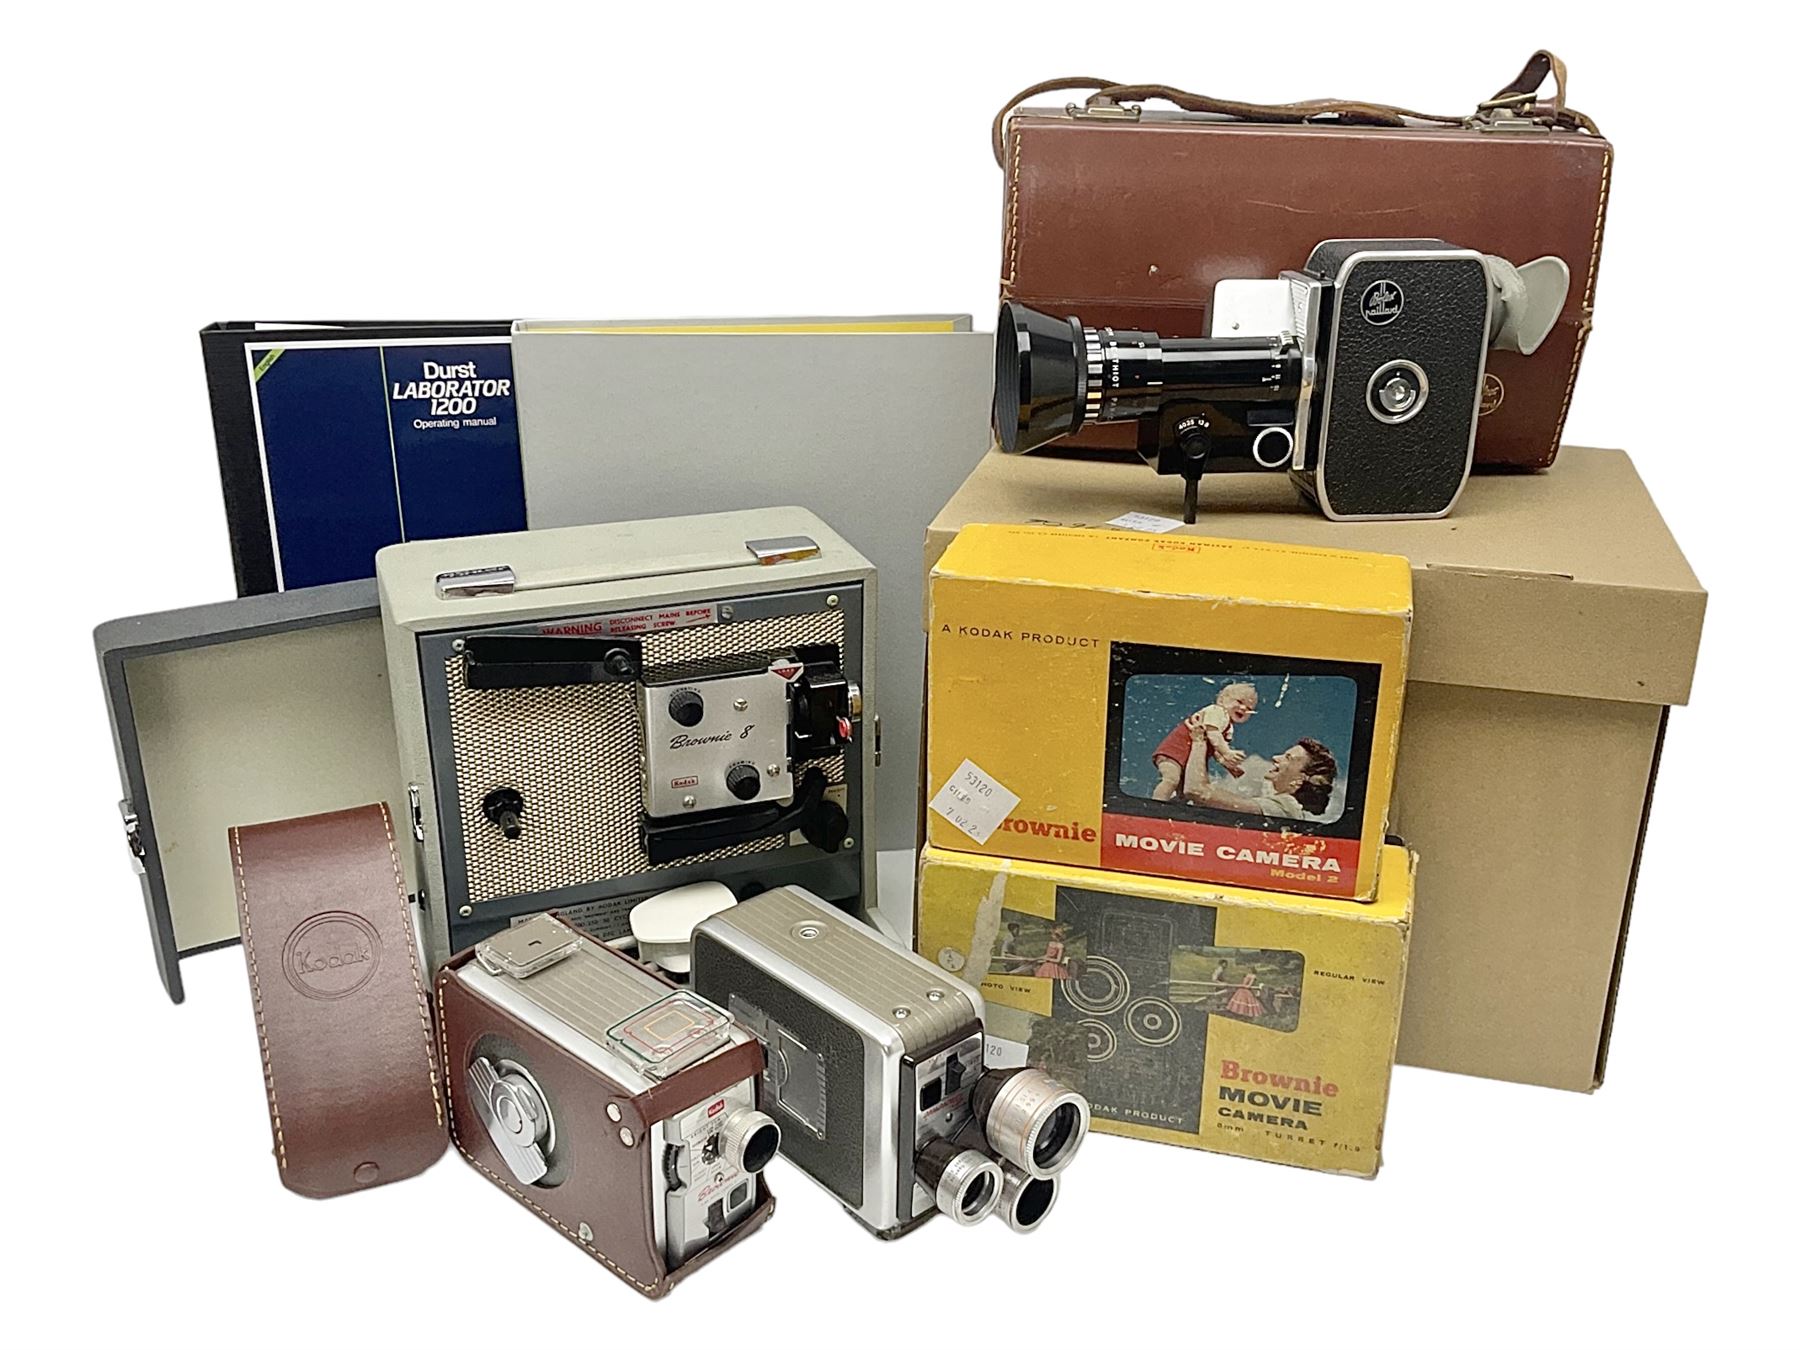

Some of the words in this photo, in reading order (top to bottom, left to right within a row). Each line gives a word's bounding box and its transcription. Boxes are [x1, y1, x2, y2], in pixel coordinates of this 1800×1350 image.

[423, 361, 477, 379] Durst
[392, 379, 511, 399] LABORATOR
[430, 398, 477, 415] 1200
[413, 419, 460, 430] Operating
[463, 417, 497, 426] manual
[609, 615, 653, 625] DISCONNECT
[686, 608, 711, 617] BEFORE
[543, 622, 602, 636] WARNING
[610, 624, 647, 633] RELEASING
[942, 624, 951, 633] A
[959, 626, 1013, 640] KODAK
[1021, 632, 1100, 648] PRODUCT
[669, 731, 732, 750] Brownie
[739, 724, 756, 739] 8
[964, 771, 993, 798] 53120
[998, 817, 1097, 842] rownie
[1115, 833, 1205, 857] MOVIE
[1216, 846, 1341, 873] CAMERA
[1270, 868, 1321, 882] Model
[1327, 875, 1339, 883] 2
[296, 942, 370, 975] Kodak
[1313, 970, 1355, 980] REGULAR
[1362, 977, 1385, 985] VIEW
[1010, 985, 1031, 993] VIEW
[1220, 1059, 1339, 1097] Brownie
[1219, 1086, 1322, 1116] MOVIE
[1087, 1102, 1118, 1113] ODAK
[1125, 1108, 1183, 1125] PRODUCT
[1218, 1107, 1308, 1131] CAMERA
[1265, 1130, 1326, 1146] TURRET
